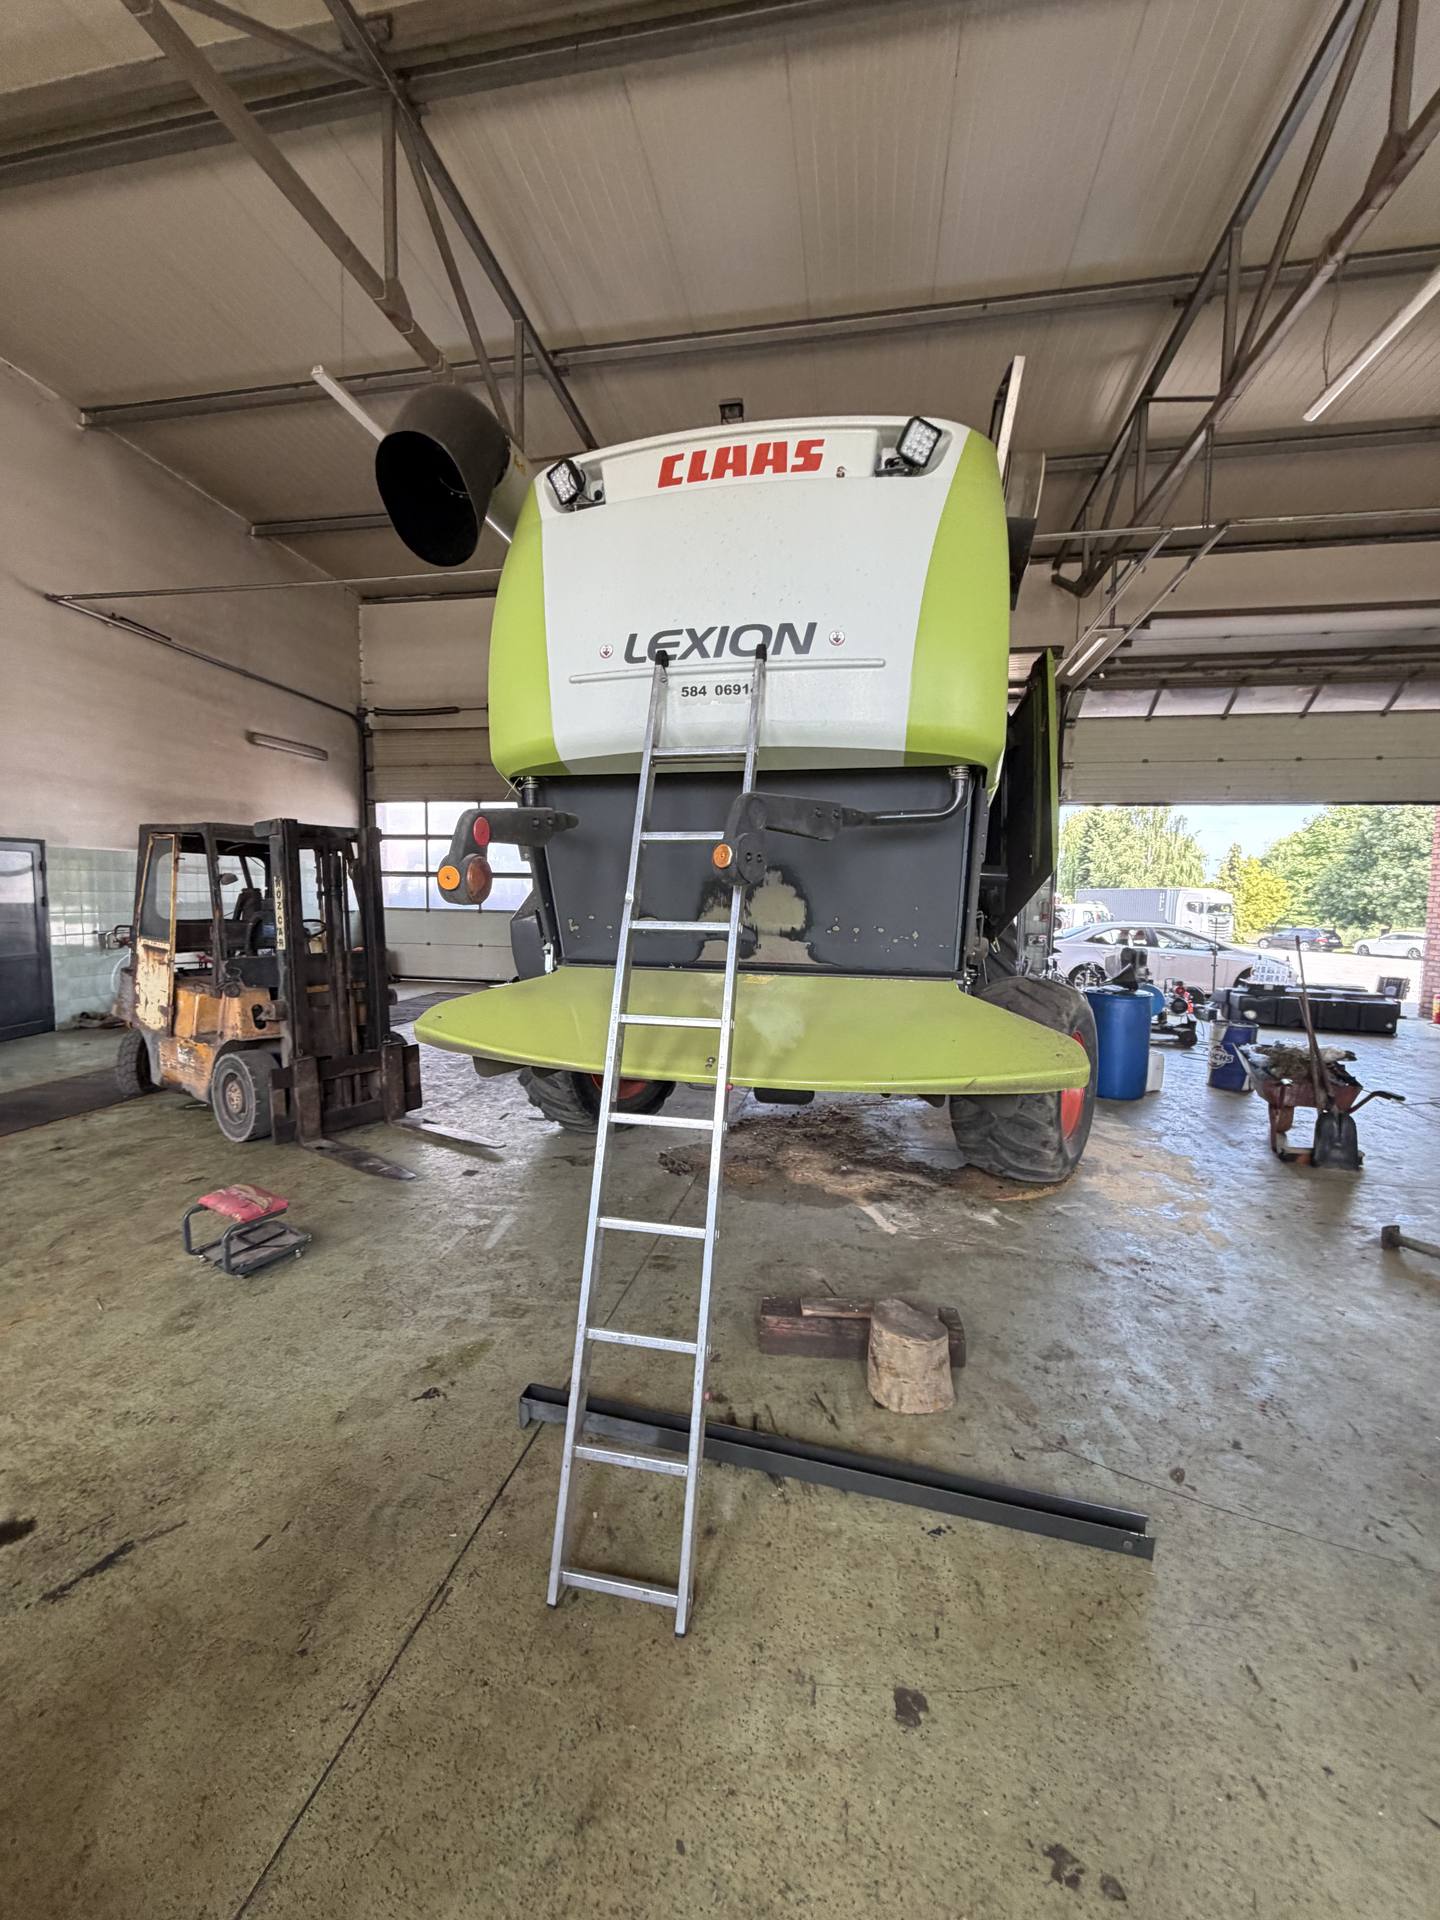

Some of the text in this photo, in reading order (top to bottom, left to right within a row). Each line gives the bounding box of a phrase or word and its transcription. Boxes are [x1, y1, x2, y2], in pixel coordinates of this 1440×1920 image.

[658, 439, 825, 488] CLAAS
[624, 622, 817, 664] LEXION
[681, 683, 753, 697] 584 0691
